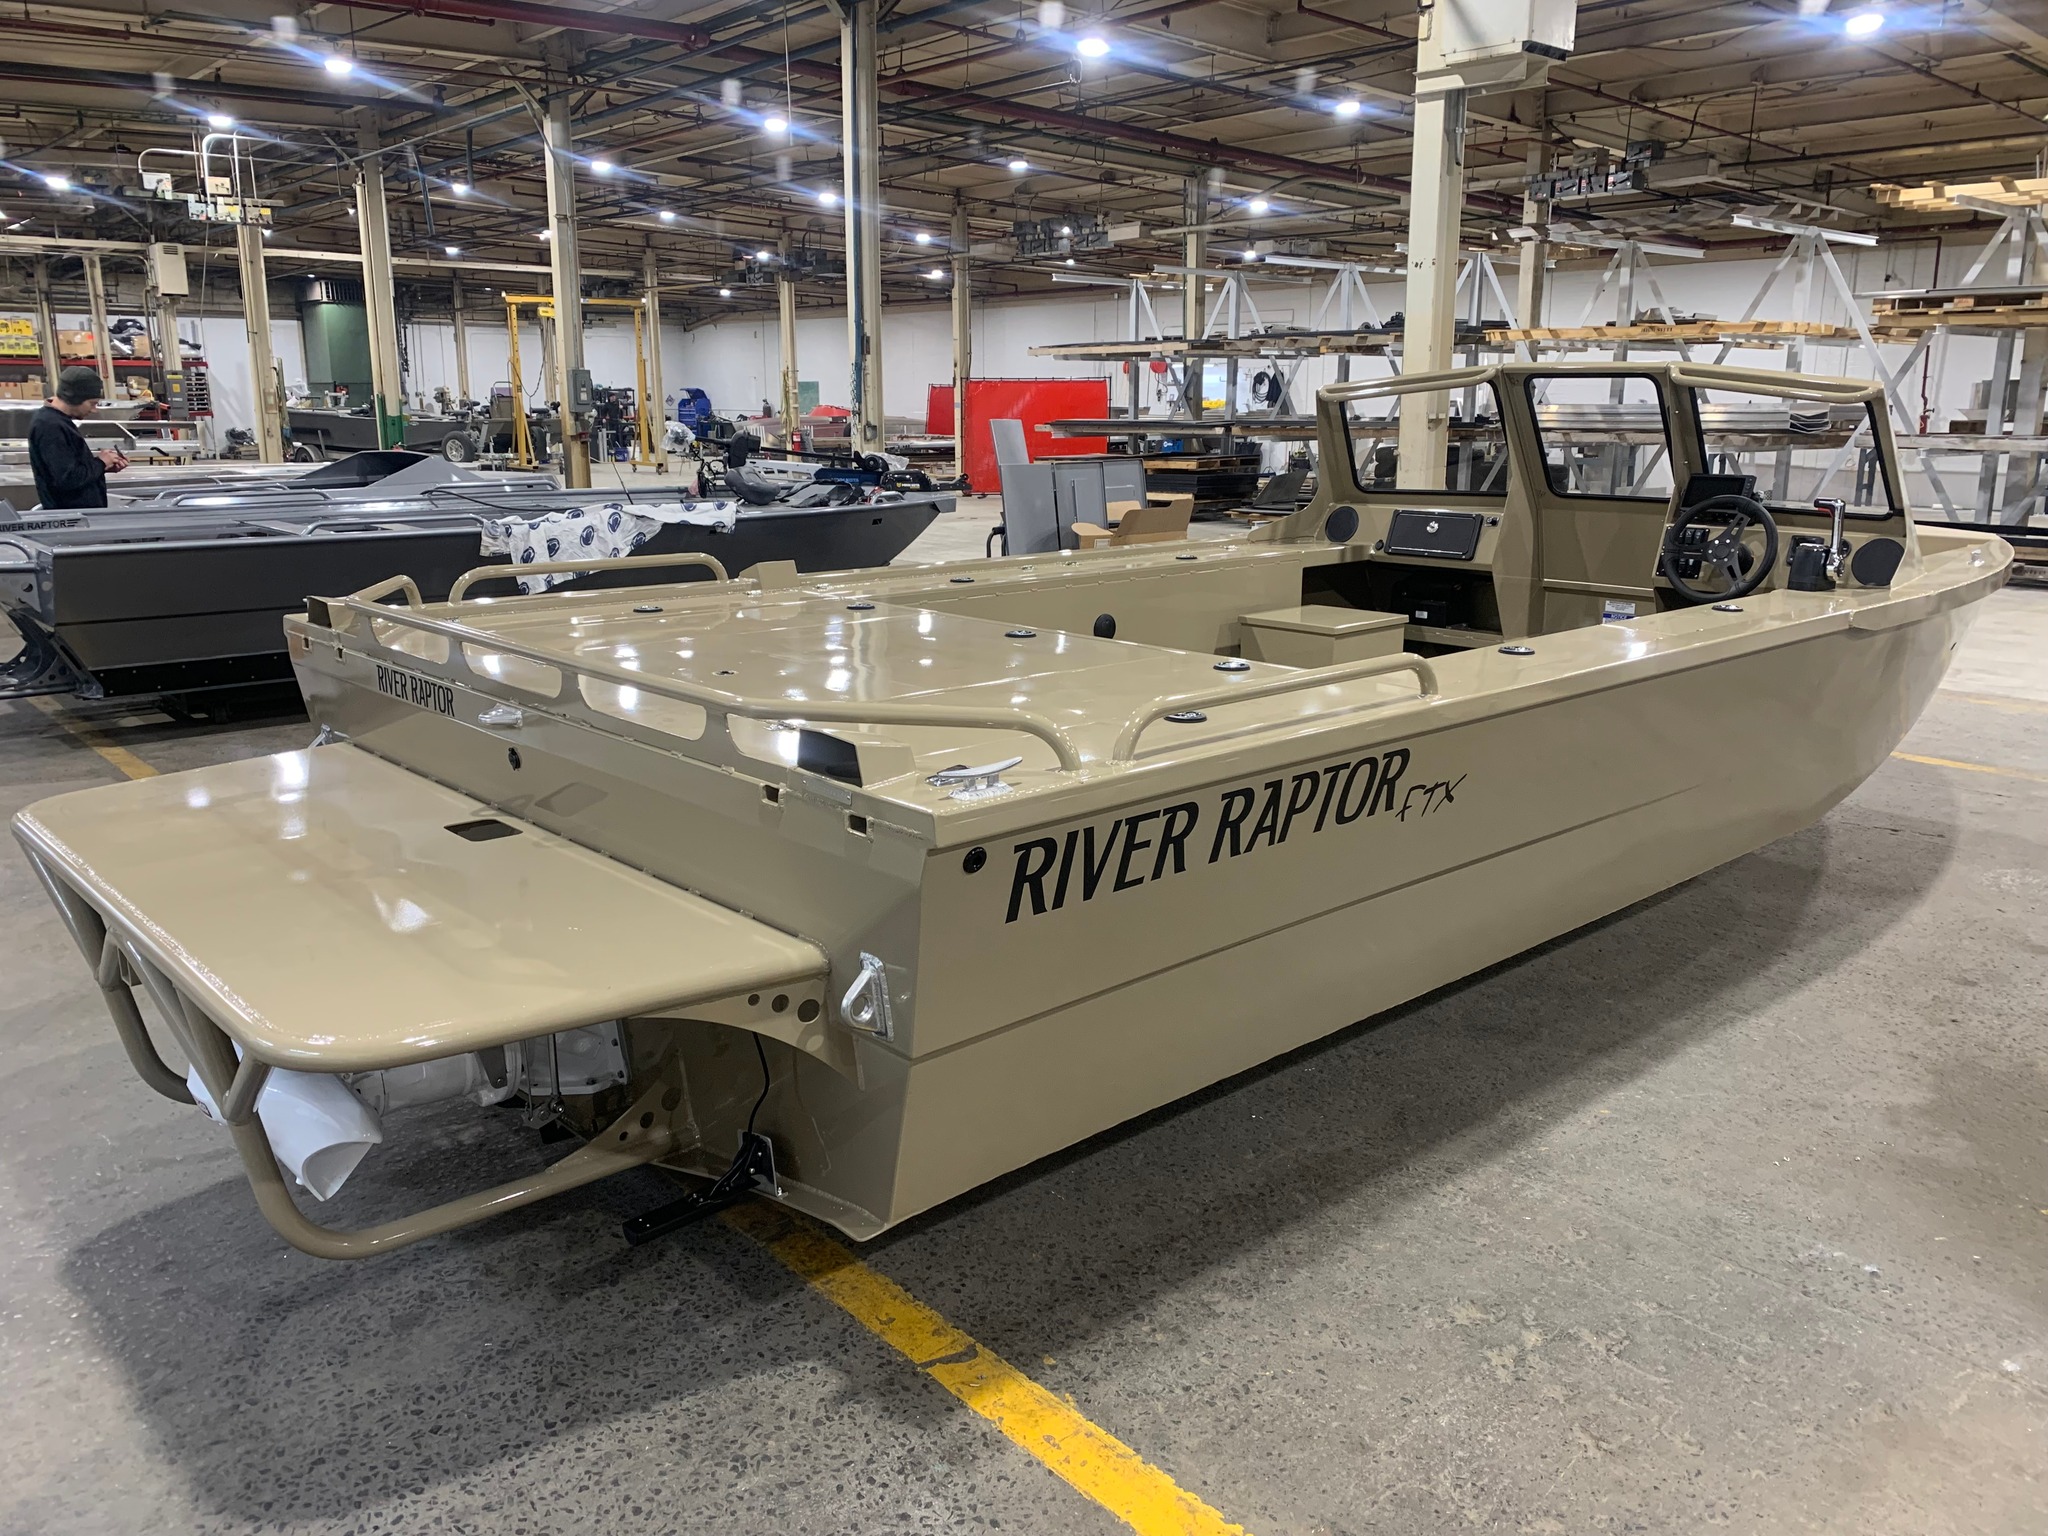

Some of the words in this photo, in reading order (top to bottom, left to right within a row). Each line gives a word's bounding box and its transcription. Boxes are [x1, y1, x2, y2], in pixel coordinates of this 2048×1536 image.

[0, 523, 24, 532] IVER
[27, 520, 66, 530] RAPTOR
[376, 664, 409, 700] RIVER
[410, 675, 455, 717] RAPTOR
[1005, 801, 1200, 924] RIVER
[1208, 748, 1411, 864] RAPTOR
[1395, 773, 1468, 822] FTX
